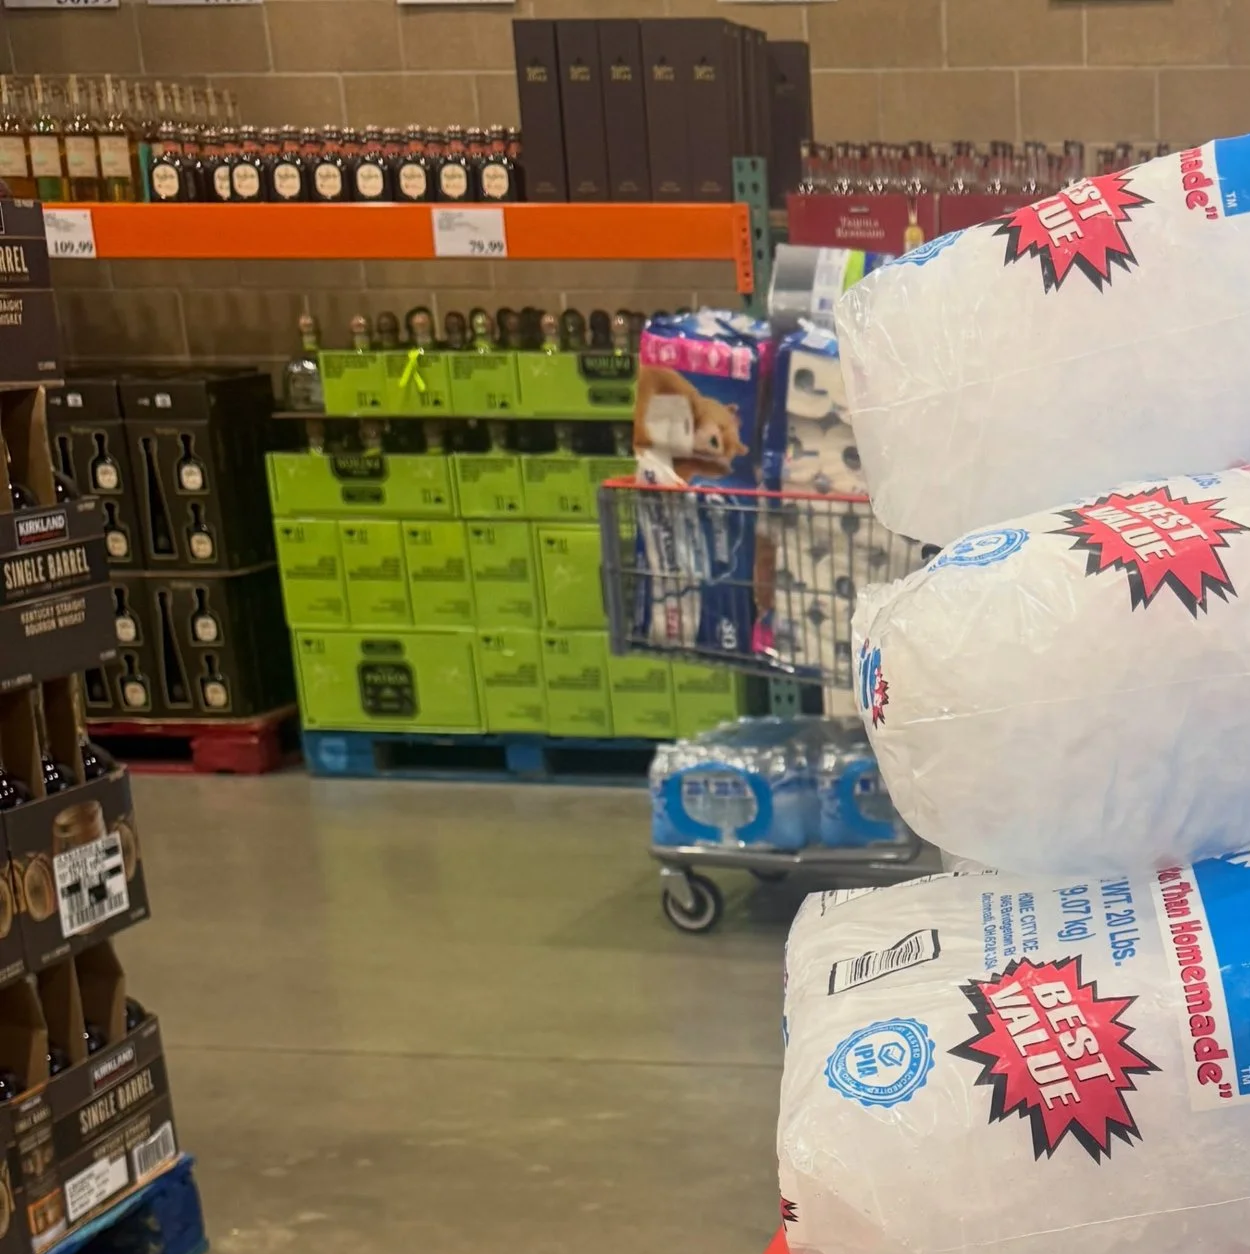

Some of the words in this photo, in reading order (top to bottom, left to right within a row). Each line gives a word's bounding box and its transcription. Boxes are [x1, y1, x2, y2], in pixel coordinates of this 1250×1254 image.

[1059, 177, 1114, 221] EST
[1179, 148, 1219, 221] made”
[0, 246, 29, 273] RREL
[18, 514, 65, 535] KIRKLAND
[1088, 504, 1176, 563] VALUE
[1126, 500, 1208, 542] BEST
[4, 556, 44, 590] SINGLE
[48, 546, 90, 578] BARREL
[1100, 880, 1133, 910] WT.
[1020, 914, 1037, 936] CITY
[1106, 909, 1136, 927] 20
[1022, 937, 1038, 953] ICE
[1109, 928, 1141, 967] Lbs.
[990, 980, 1081, 1111] VALUE
[1032, 981, 1115, 1083] BEST
[854, 1043, 878, 1078] IPIA
[80, 1093, 117, 1134] SINGLE
[118, 1068, 154, 1110] BARREL
